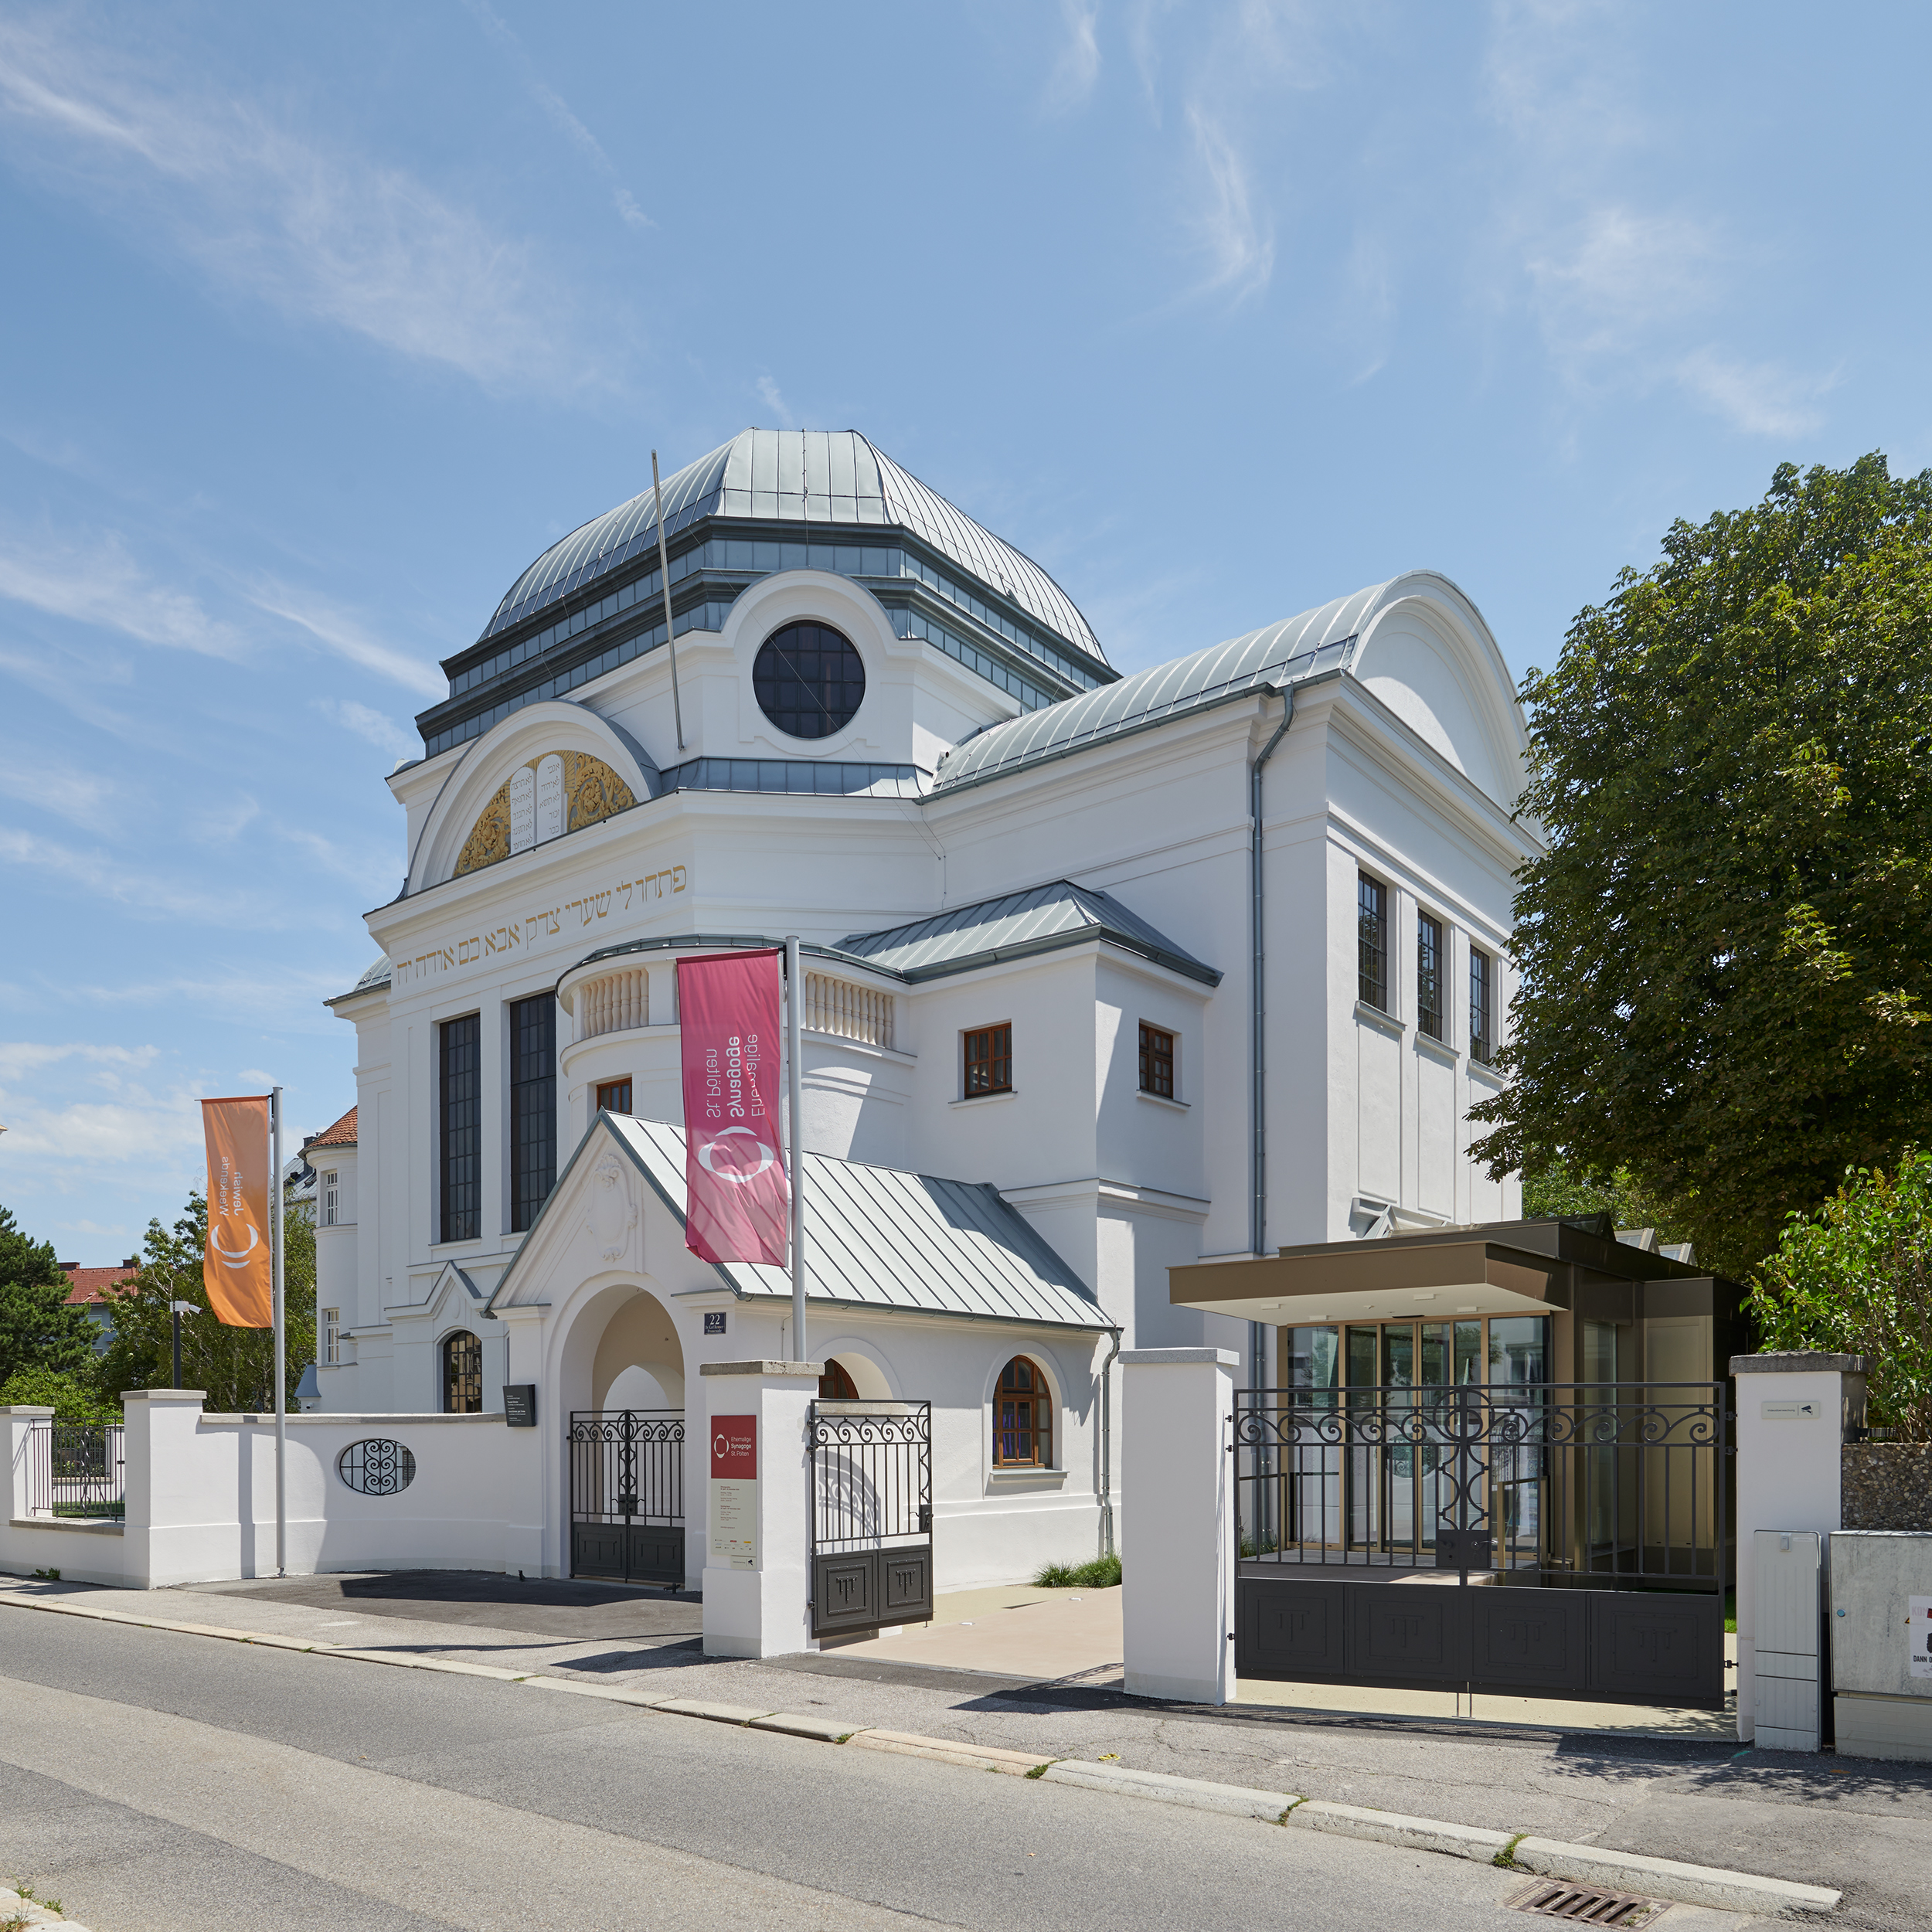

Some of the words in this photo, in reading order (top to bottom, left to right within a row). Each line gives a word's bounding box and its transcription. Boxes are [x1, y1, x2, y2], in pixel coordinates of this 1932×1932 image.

[565, 890, 611, 927] שערי
[617, 881, 631, 910] לי
[526, 907, 560, 950] צדק
[416, 946, 454, 978] אודה
[709, 1314, 720, 1325] 22
